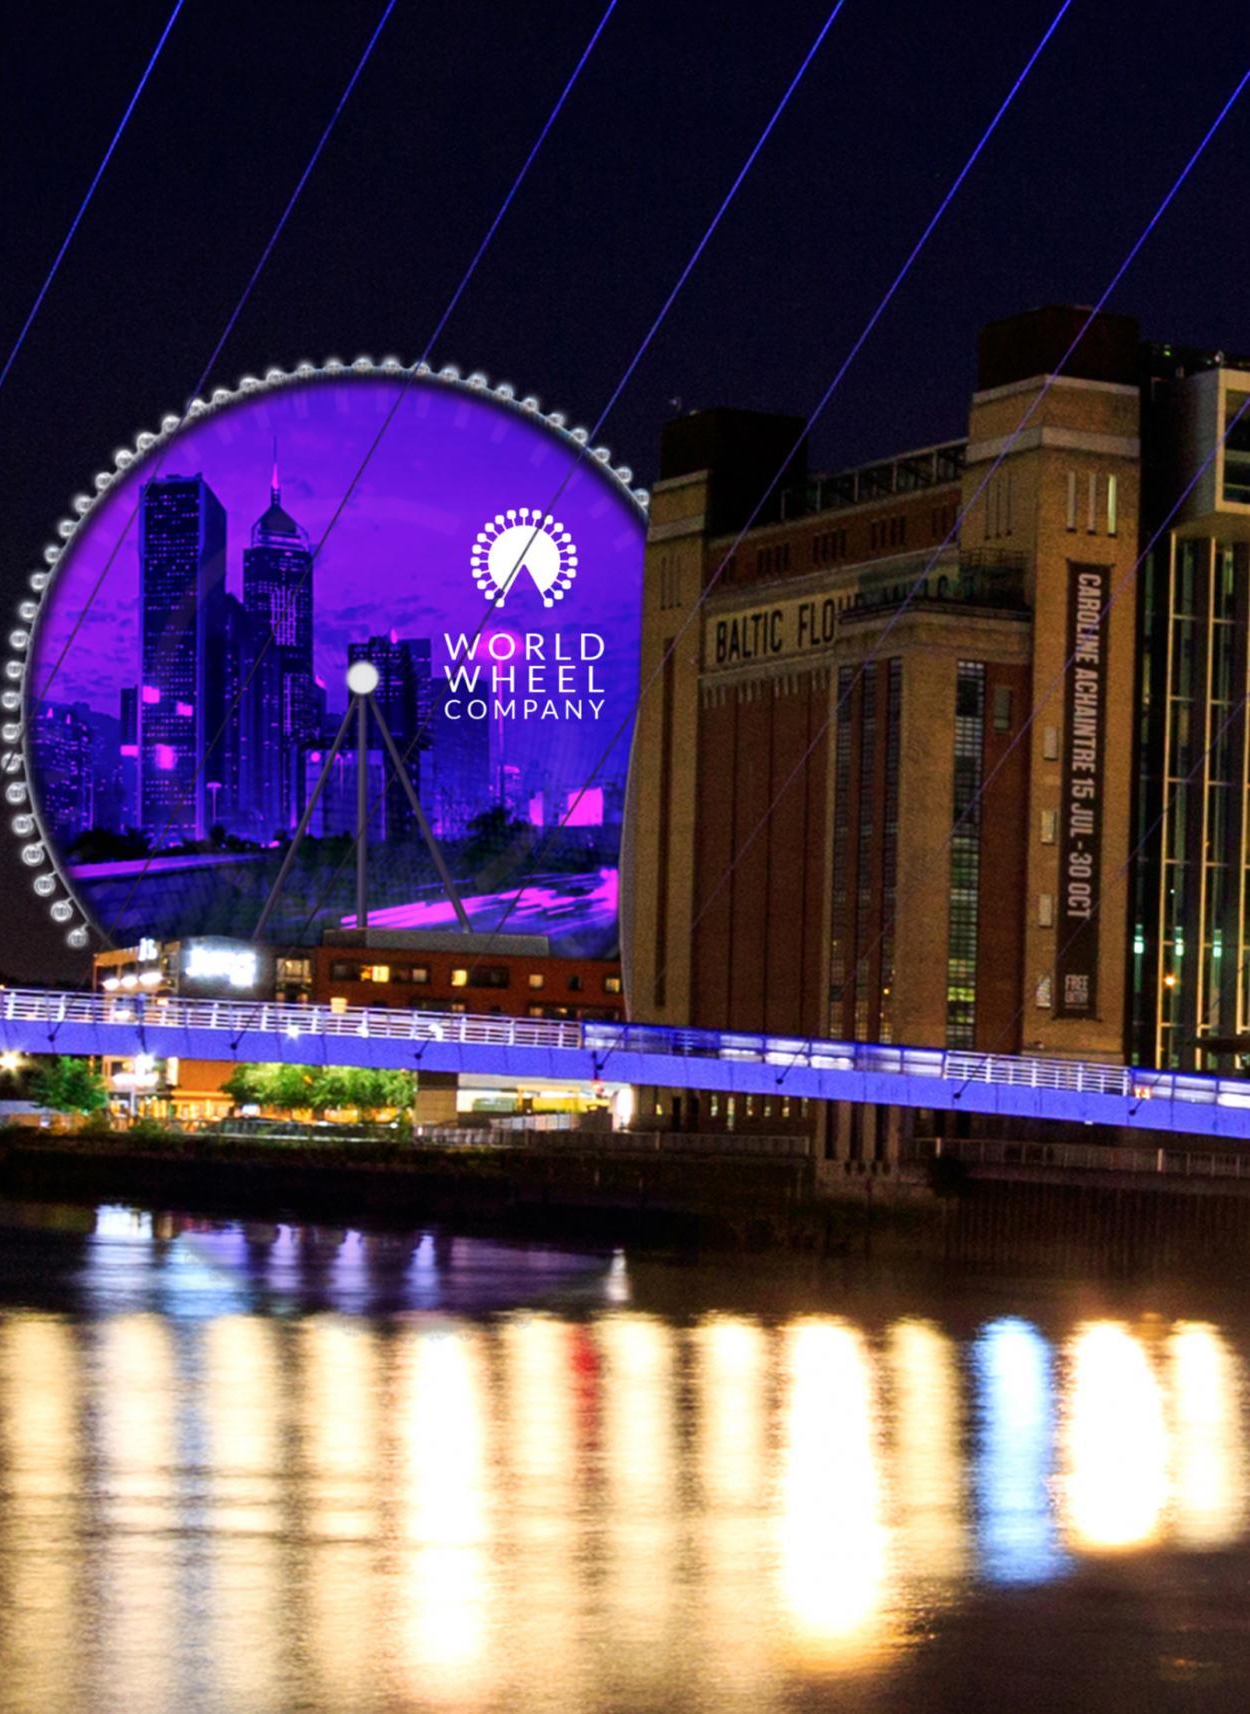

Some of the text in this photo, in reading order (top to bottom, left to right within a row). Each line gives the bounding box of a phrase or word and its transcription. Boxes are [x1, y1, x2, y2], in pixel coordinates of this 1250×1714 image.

[1075, 572, 1102, 665] CAROLINE
[443, 632, 605, 661] WORLD
[716, 609, 784, 663] BALTIC
[443, 665, 605, 693] WHEEL
[444, 699, 606, 720] COMPANY
[1071, 667, 1099, 773] ACHAINTRE
[1071, 778, 1094, 799] 15
[1069, 805, 1094, 838] JUL
[1068, 852, 1093, 878] 30
[1067, 882, 1092, 920] OCT
[1064, 974, 1090, 991] FREE
